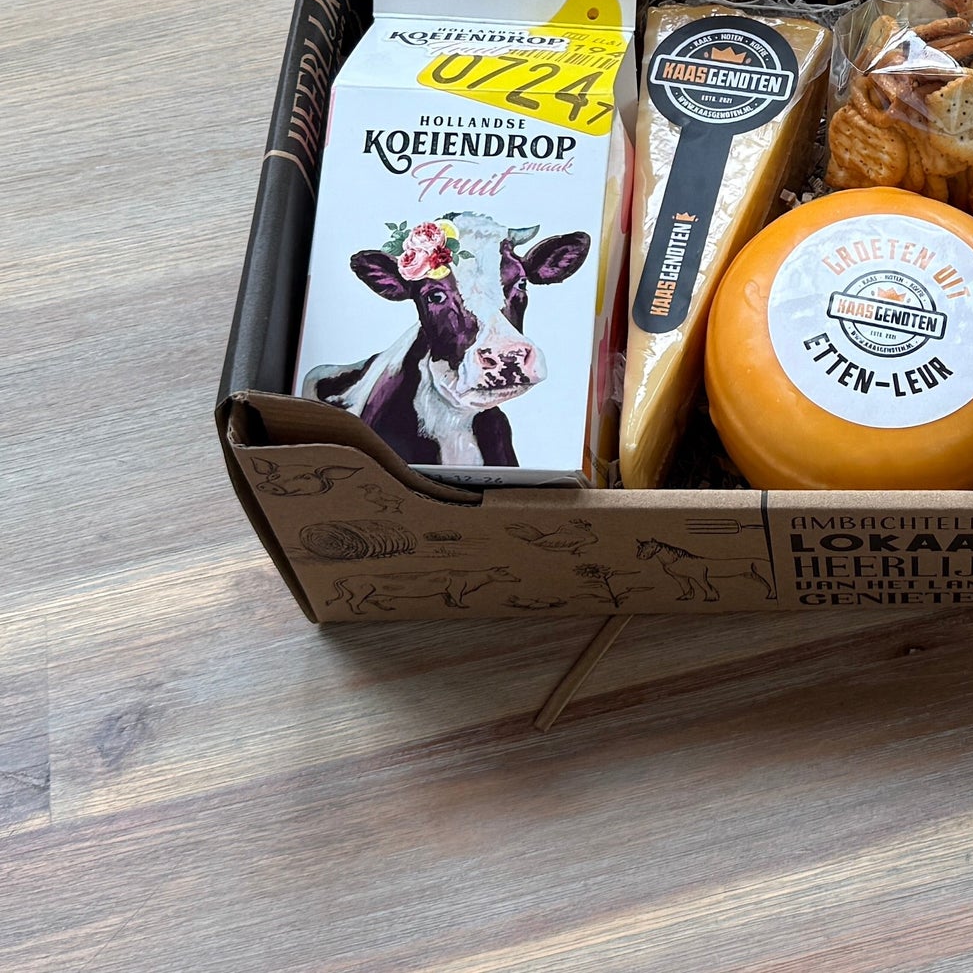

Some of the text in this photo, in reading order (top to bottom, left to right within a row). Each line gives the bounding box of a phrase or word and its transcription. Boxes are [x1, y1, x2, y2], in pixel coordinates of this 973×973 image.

[389, 30, 564, 46] KOEIENDROP
[693, 33, 769, 58] KAAS NOTEN KOFFIE
[431, 52, 604, 122] 0724
[662, 62, 783, 94] KAASGENOTEN
[420, 115, 526, 129] HOLLANDSE
[586, 101, 614, 126] 7
[363, 129, 577, 175] KOEIENDROP
[520, 156, 574, 175] smaak
[411, 158, 526, 203] Fruit
[650, 222, 692, 317] KAASGENOTEN
[821, 238, 971, 301] GROETEN UIT
[837, 298, 938, 333] KAASGENOTEN
[803, 332, 954, 398] ETTEN-LEUR
[796, 580, 857, 590] VAN
[867, 580, 919, 590] HET
